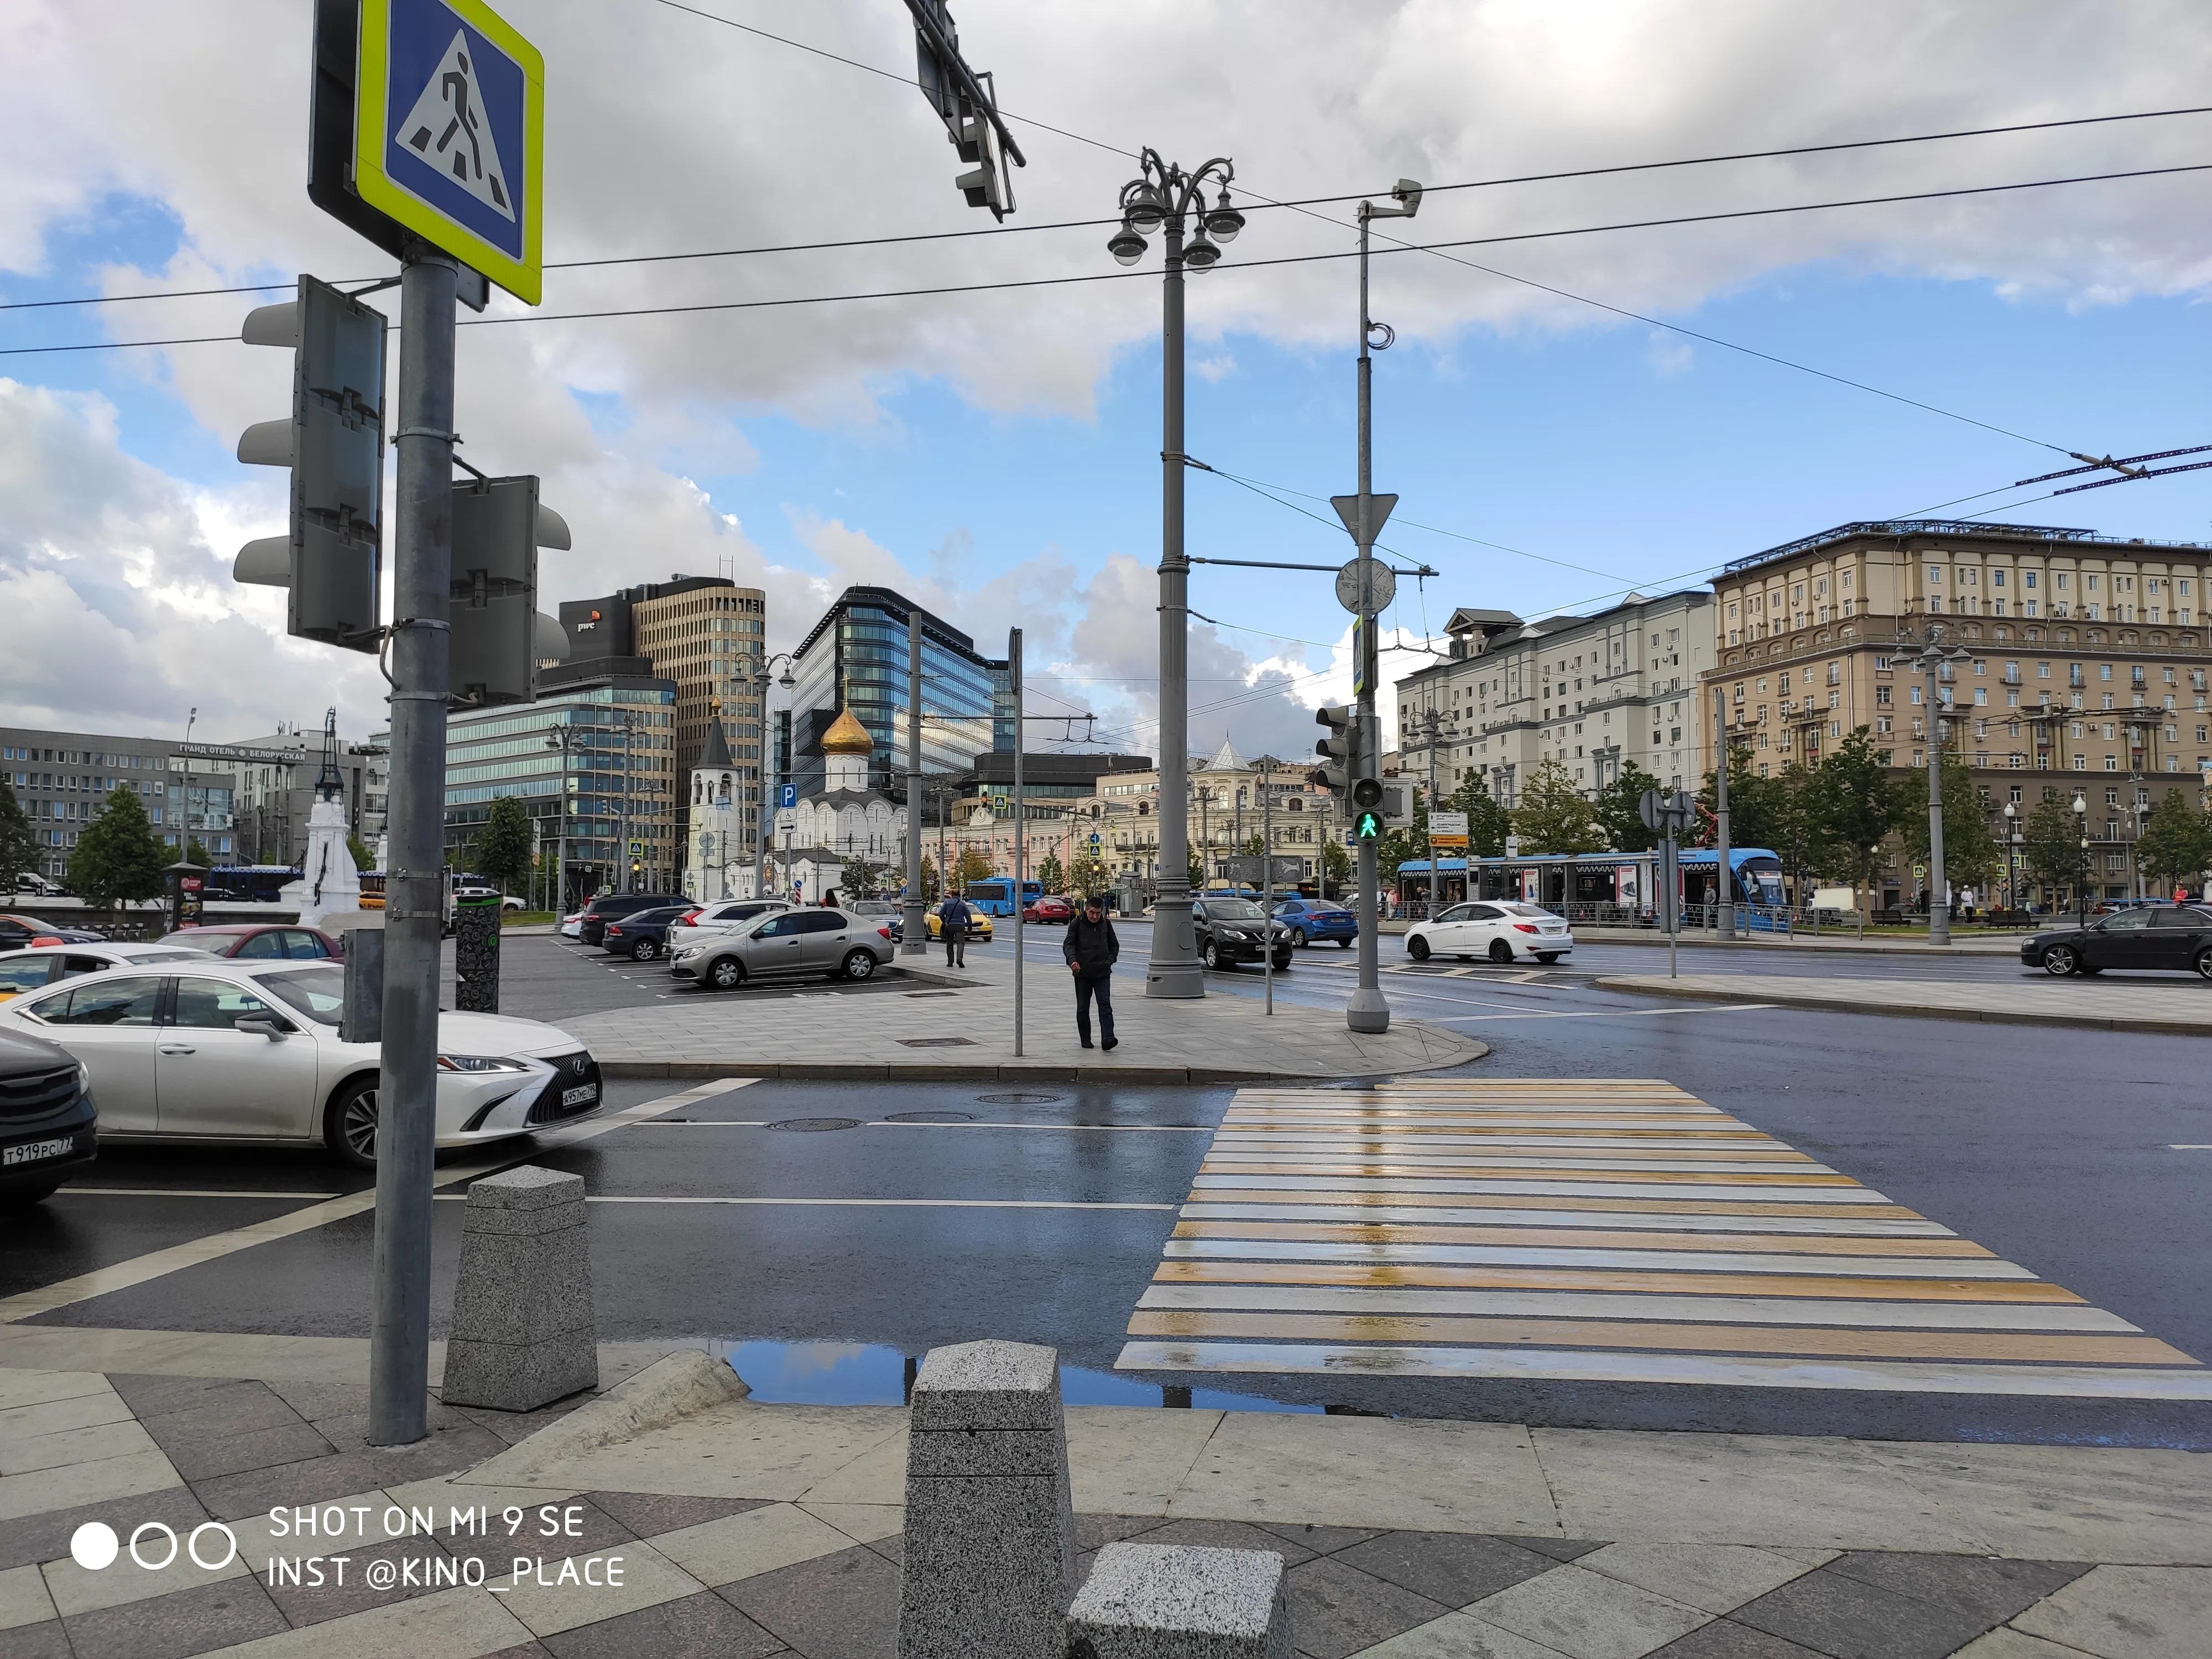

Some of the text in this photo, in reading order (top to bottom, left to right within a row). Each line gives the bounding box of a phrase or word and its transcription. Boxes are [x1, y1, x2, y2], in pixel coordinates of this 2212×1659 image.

[578, 622, 595, 632] pwc
[179, 744, 305, 761] ГРАНД ОТЕЛЬ БЕЛОРУССКАЯ
[785, 787, 794, 805] P
